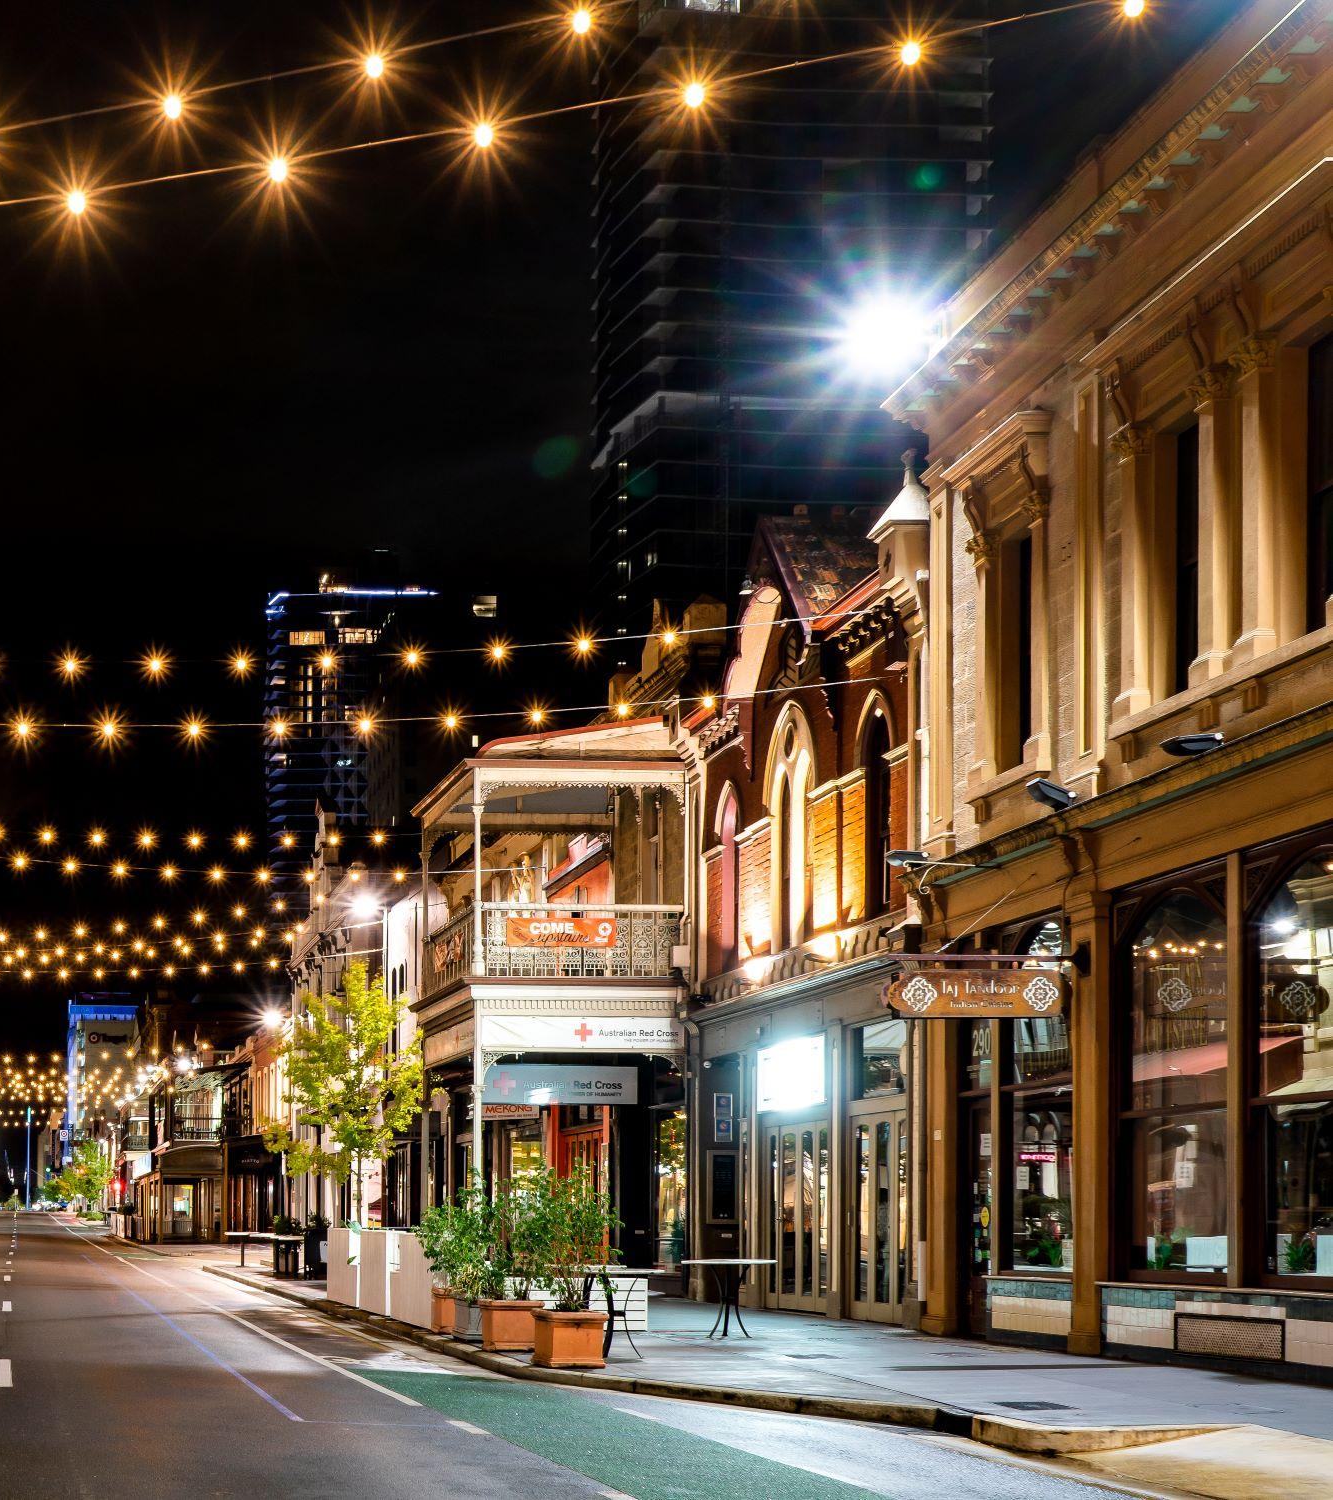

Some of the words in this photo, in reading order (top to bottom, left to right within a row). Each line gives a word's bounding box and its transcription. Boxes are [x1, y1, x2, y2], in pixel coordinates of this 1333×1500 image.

[529, 922, 575, 934] COME
[950, 1000, 978, 1008] Indian
[981, 1000, 1013, 1008] Cuisine
[599, 1029, 637, 1037] Australian
[639, 1029, 654, 1037] Red
[656, 1029, 679, 1037] Cross
[972, 1028, 991, 1057] 290
[523, 1080, 568, 1090] Australia
[574, 1080, 592, 1090] Red
[595, 1080, 623, 1090] Cross
[485, 1104, 533, 1114] MEKONG
